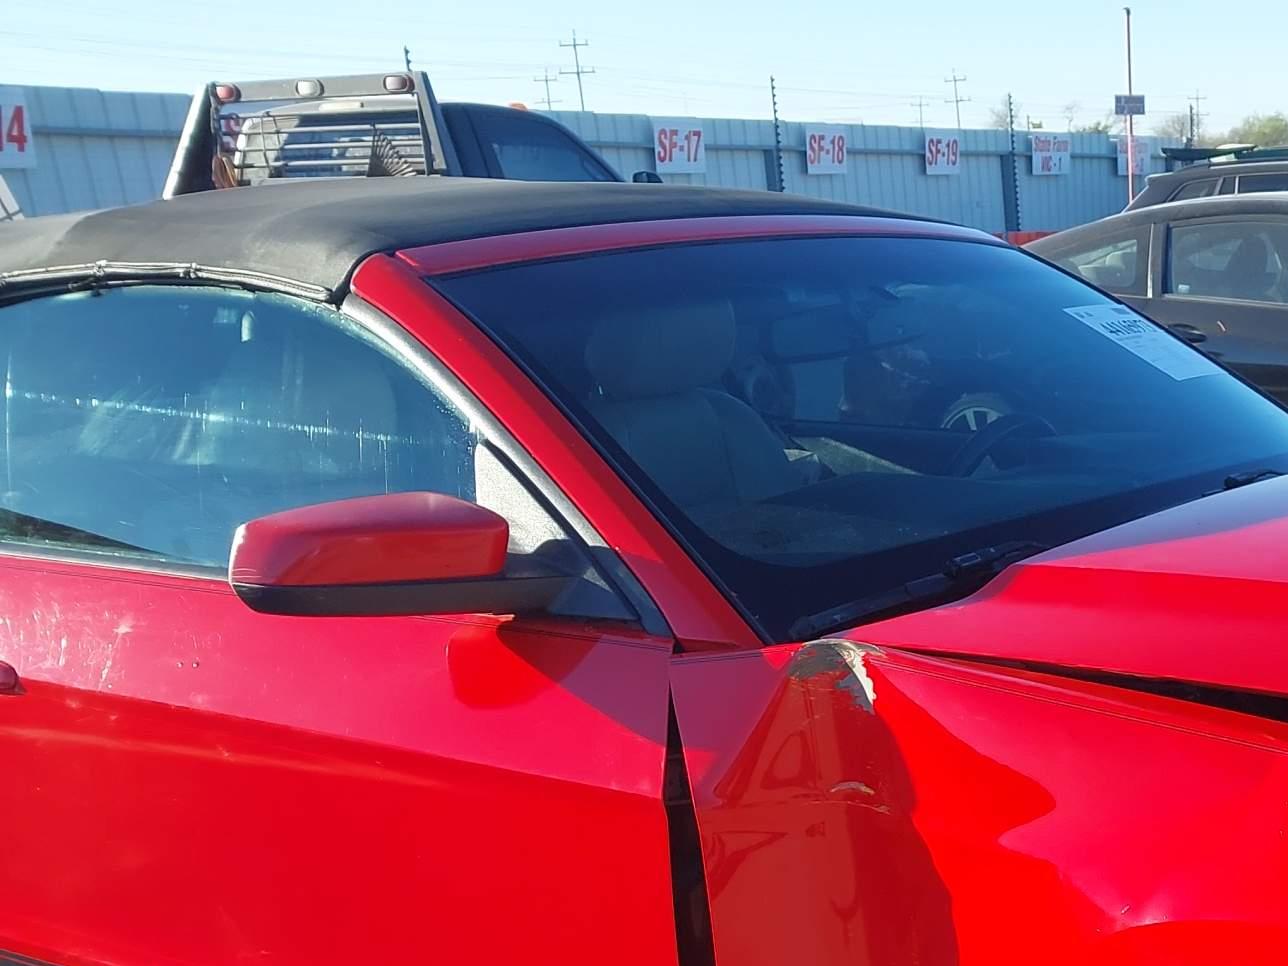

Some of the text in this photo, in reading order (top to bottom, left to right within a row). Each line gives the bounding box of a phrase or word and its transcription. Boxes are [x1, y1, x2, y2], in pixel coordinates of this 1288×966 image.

[657, 128, 702, 163] SF-17
[808, 134, 845, 164] SF-18
[926, 138, 959, 167] SF-19
